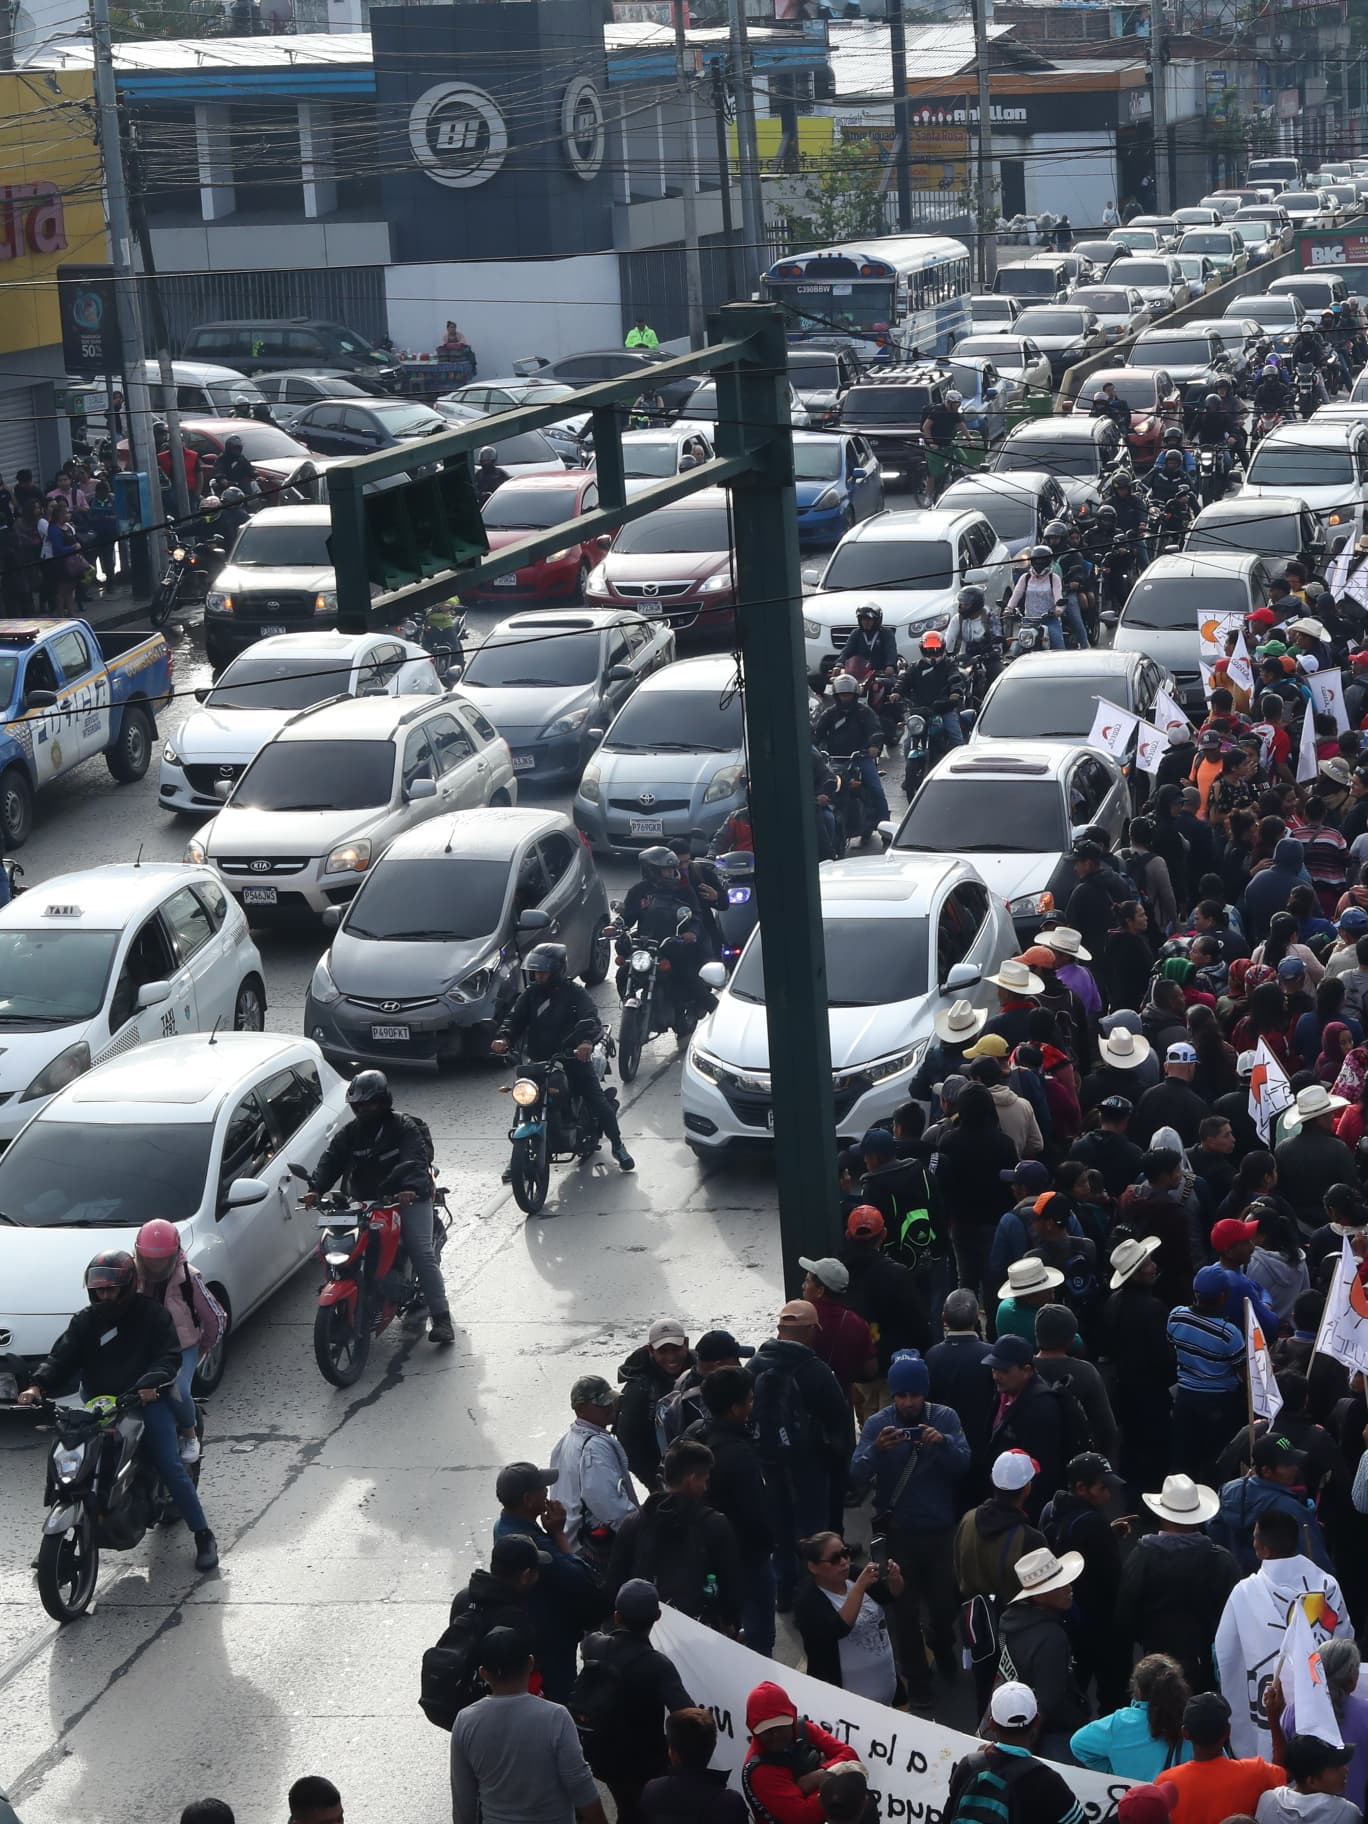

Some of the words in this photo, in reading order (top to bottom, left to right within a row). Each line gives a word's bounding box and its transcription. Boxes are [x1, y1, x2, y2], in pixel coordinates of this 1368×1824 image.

[1311, 246, 1346, 264] BIG
[253, 861, 269, 870] KIA
[49, 906, 74, 915] TAXI
[160, 1008, 175, 1026] TAXI
